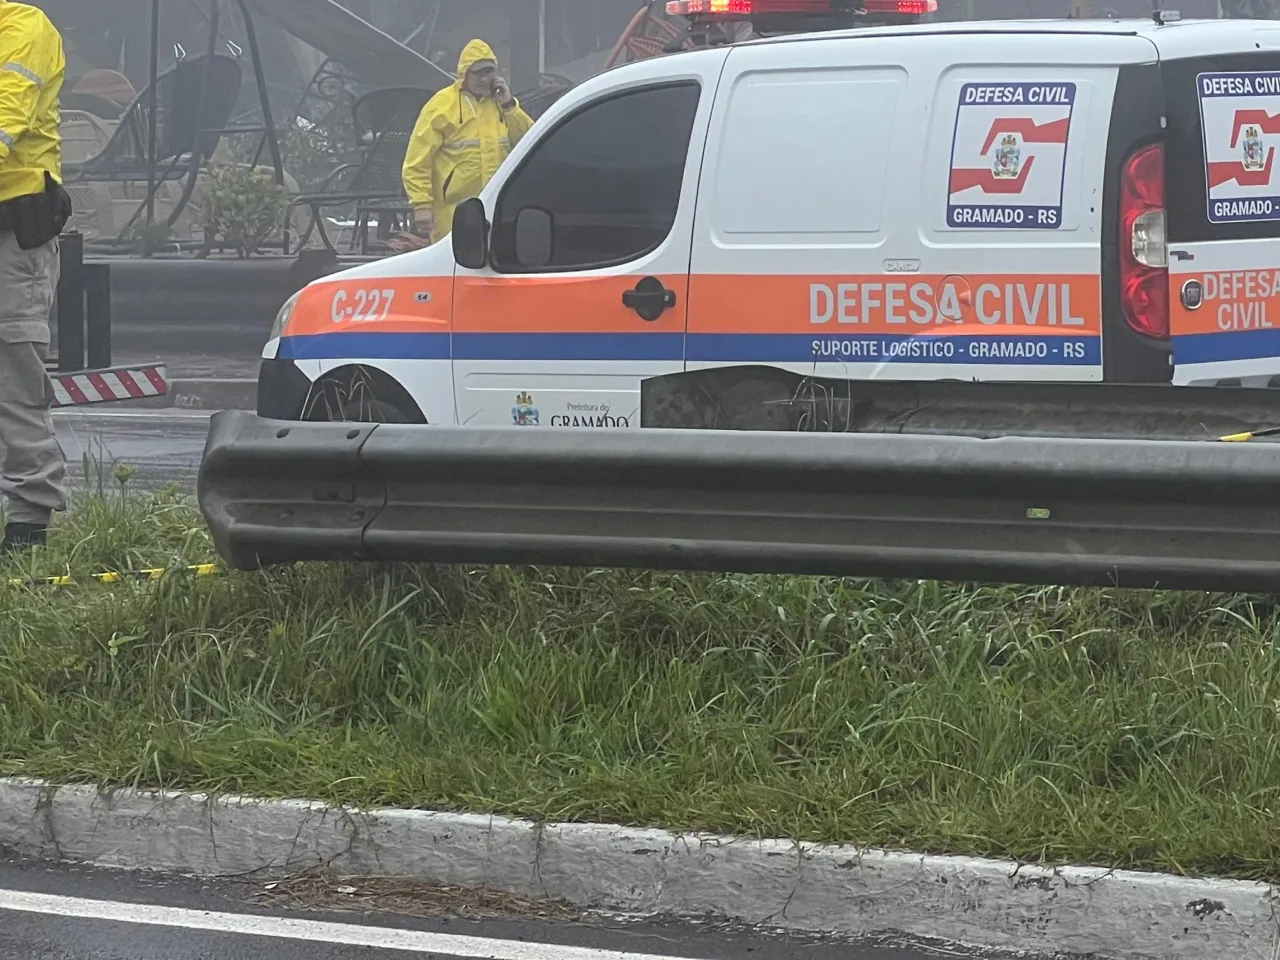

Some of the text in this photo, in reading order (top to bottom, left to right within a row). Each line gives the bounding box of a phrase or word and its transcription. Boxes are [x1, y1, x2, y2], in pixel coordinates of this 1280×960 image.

[965, 87, 1070, 103] DEFESA CIVIL
[1203, 76, 1252, 95] DEFESA
[953, 208, 1024, 224] GRAMADO
[1037, 209, 1057, 224] RS
[1214, 200, 1273, 216] GRAMADO
[331, 289, 395, 323] C-227
[809, 283, 1084, 325] DEFESA CIVIL
[1217, 302, 1273, 330] CIVIL
[812, 340, 878, 356] SUPORTE
[882, 338, 954, 357] LOGÍSTICO
[969, 342, 1047, 358] GRAMADO
[1063, 342, 1085, 358] RS
[567, 402, 609, 411] Prefeitura de
